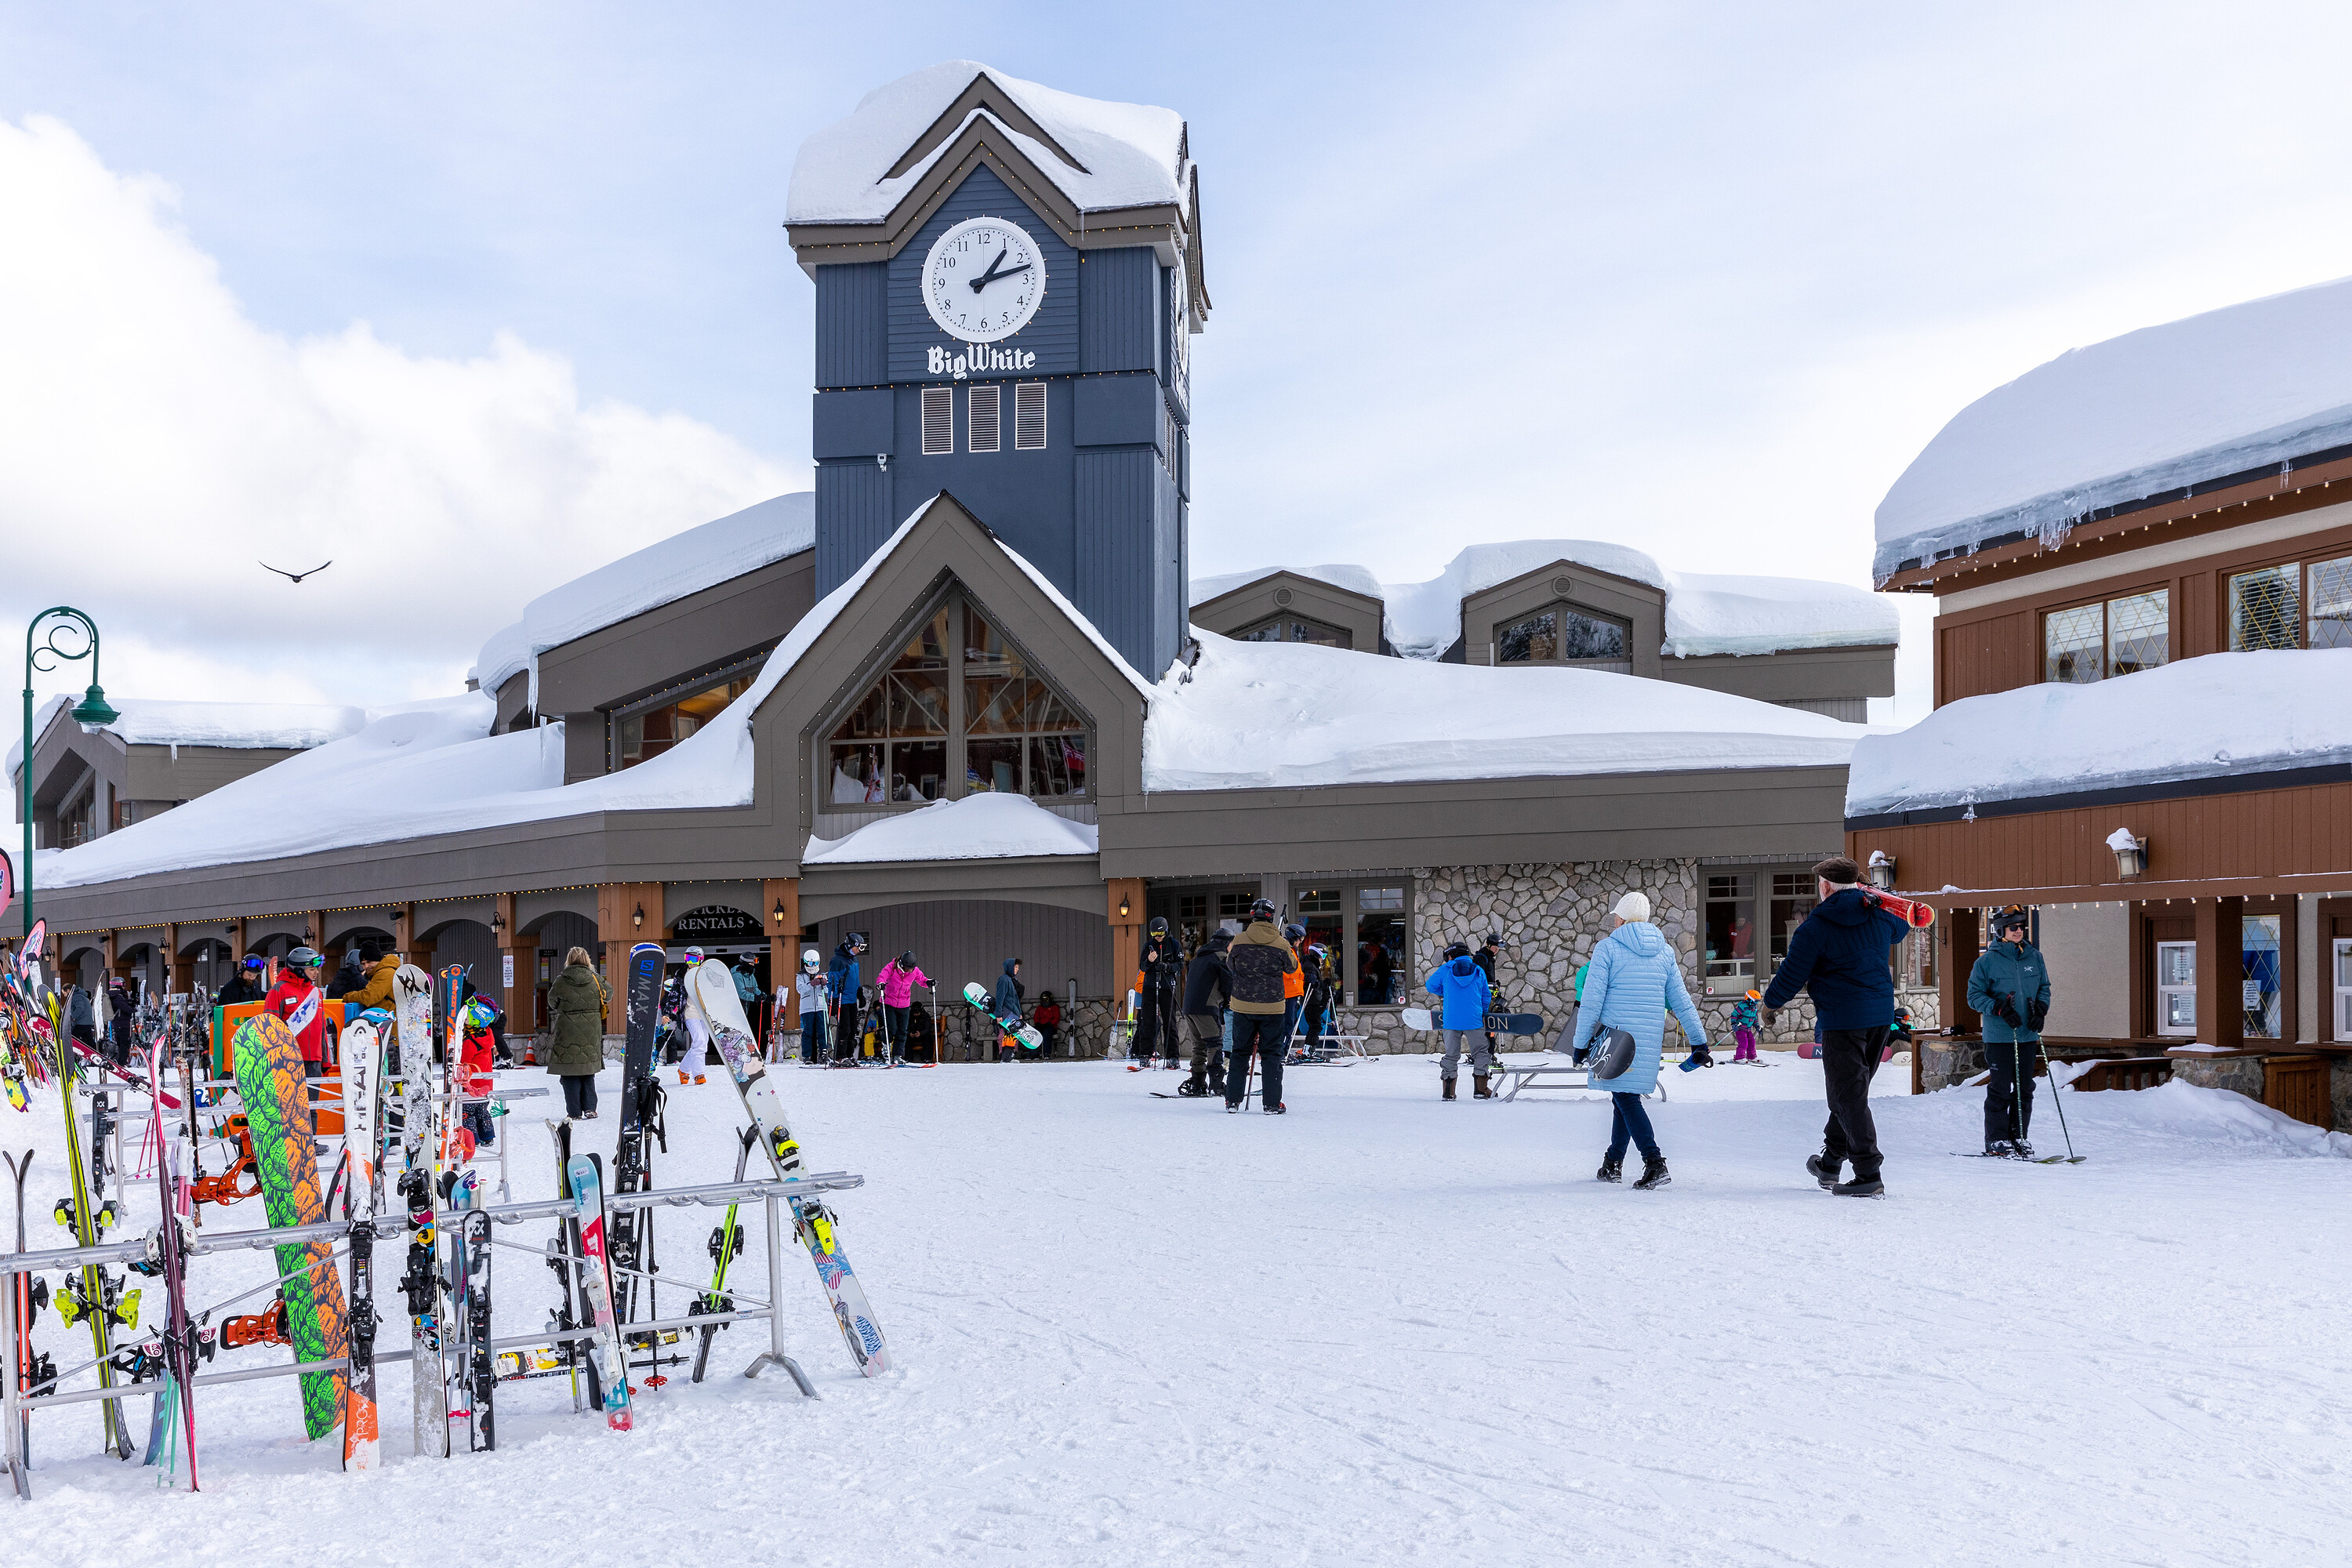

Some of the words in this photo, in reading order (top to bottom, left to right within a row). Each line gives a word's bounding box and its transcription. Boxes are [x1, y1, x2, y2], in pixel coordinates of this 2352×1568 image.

[978, 234, 990, 245] 12
[1003, 238, 1007, 249] 1
[958, 241, 968, 252] 11
[943, 257, 956, 268] 10
[1017, 253, 1023, 263] 2
[938, 278, 946, 289] 9
[1023, 274, 1029, 285] 3
[945, 299, 951, 310] 8
[1017, 296, 1024, 306] 4
[960, 314, 967, 325] 7
[1002, 312, 1008, 322] 5
[981, 318, 988, 328] 6
[678, 916, 745, 931] RENTALS
